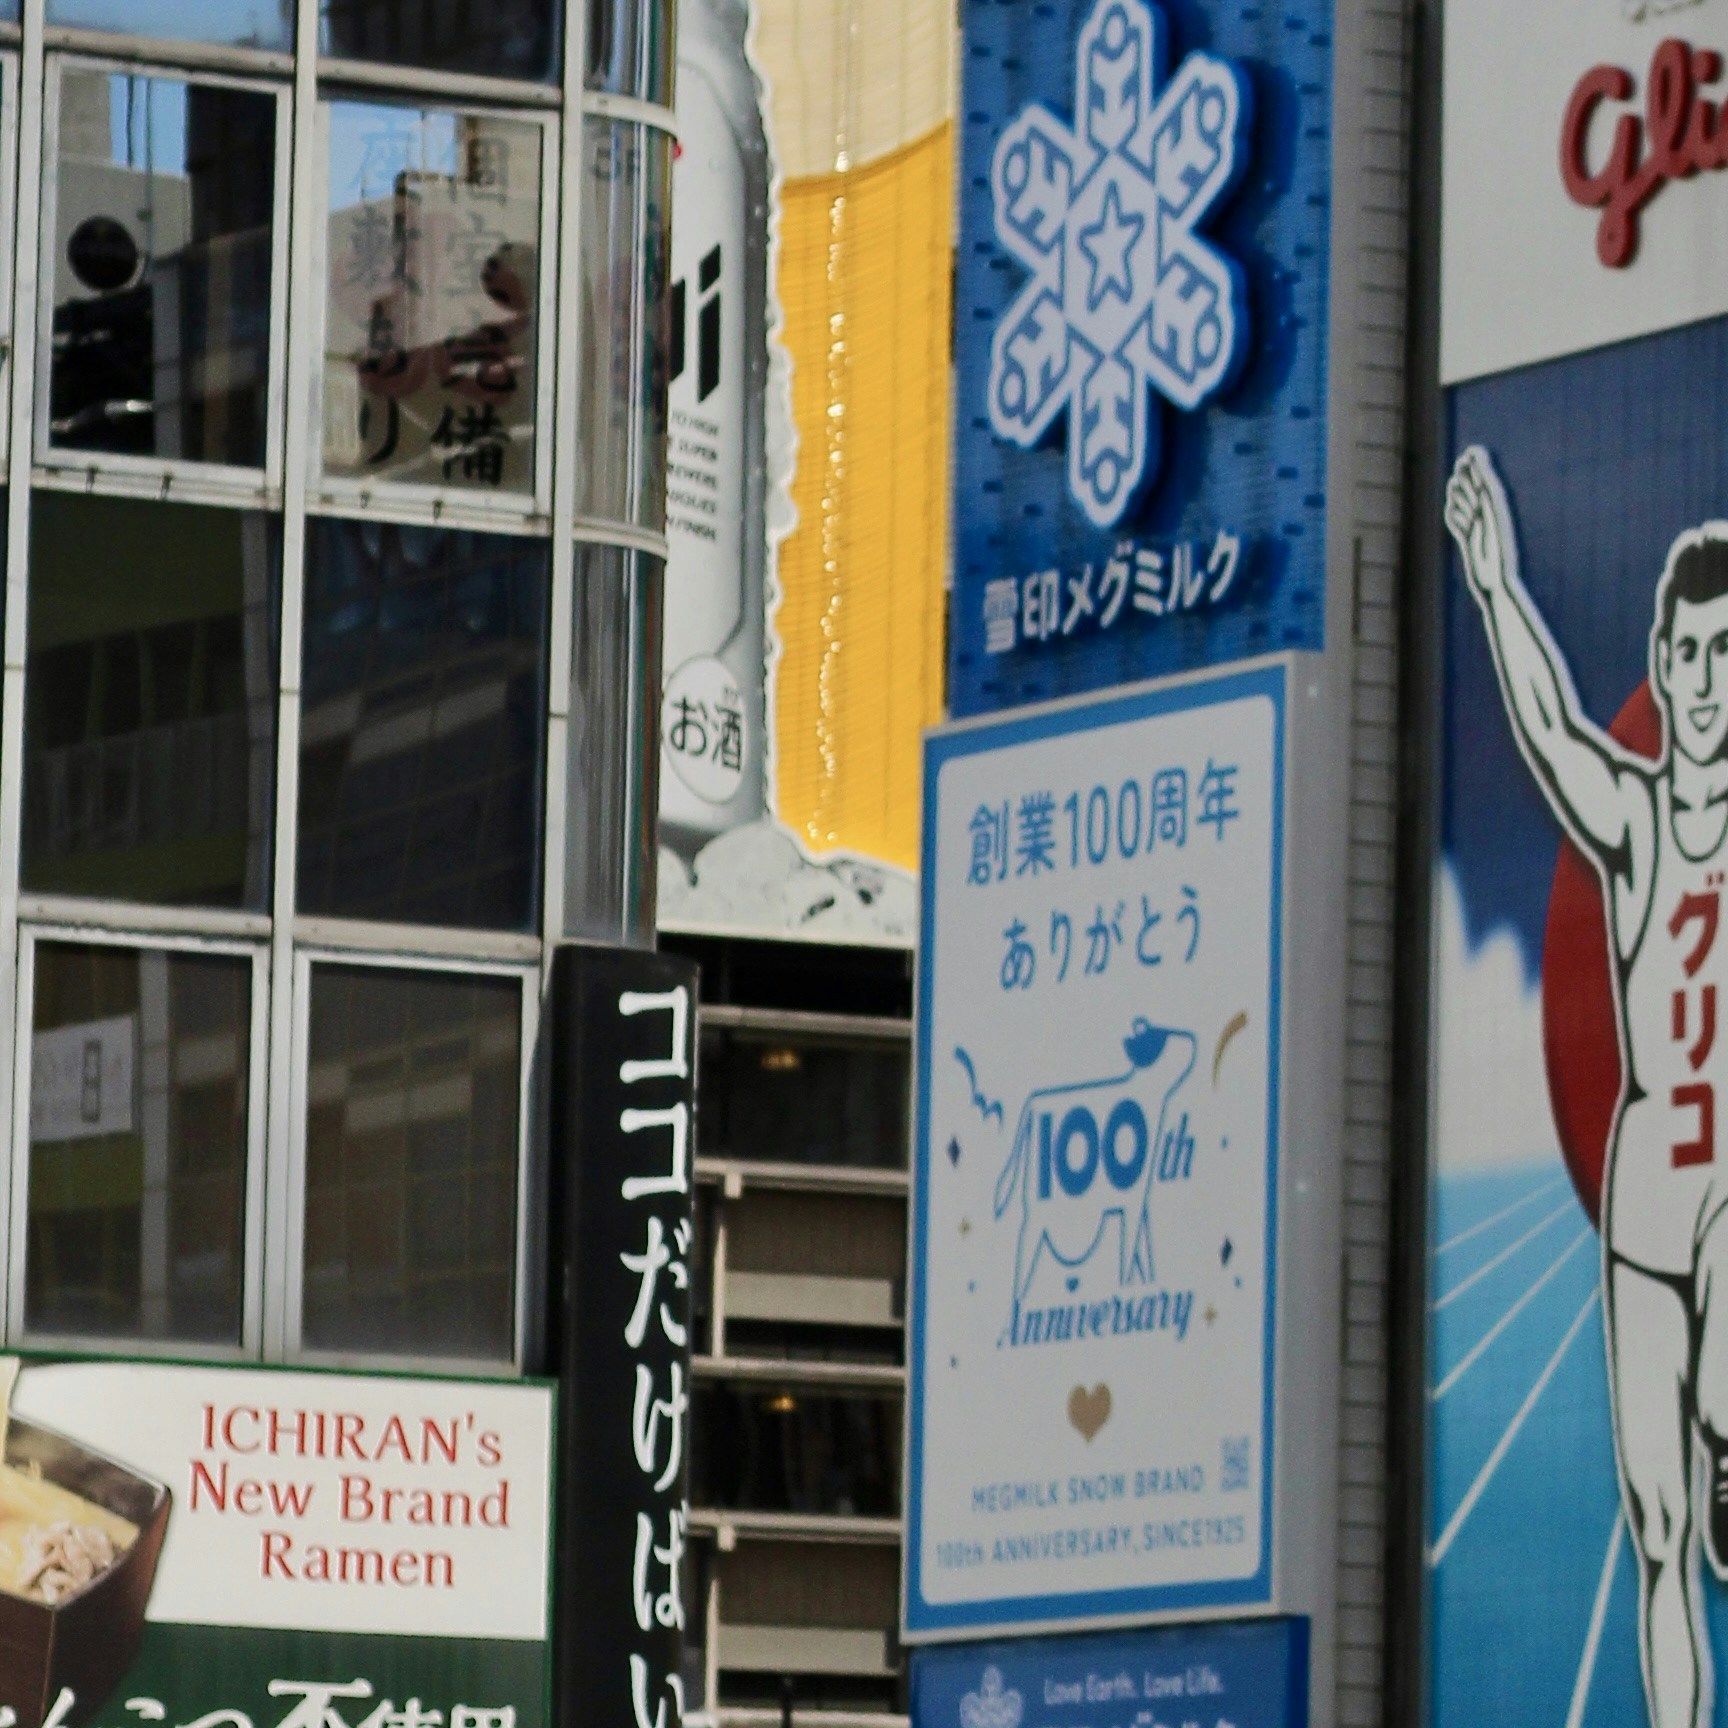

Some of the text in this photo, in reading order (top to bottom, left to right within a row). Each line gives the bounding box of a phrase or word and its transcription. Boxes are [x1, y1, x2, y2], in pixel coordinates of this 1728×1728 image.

[982, 528, 1242, 654] 雪印メグミルク
[670, 695, 742, 772] お酒
[966, 756, 1241, 887] 創業100周年
[1000, 884, 1202, 991] ありがとう
[1667, 871, 1726, 1170] グリコ
[995, 1289, 1195, 1349] Anniversary
[201, 1402, 502, 1467] ICHIRAN's
[188, 1459, 510, 1529] New Brand
[972, 1464, 1205, 1513] MEGMILK SNOW BRAND
[258, 1531, 456, 1589] Ramen
